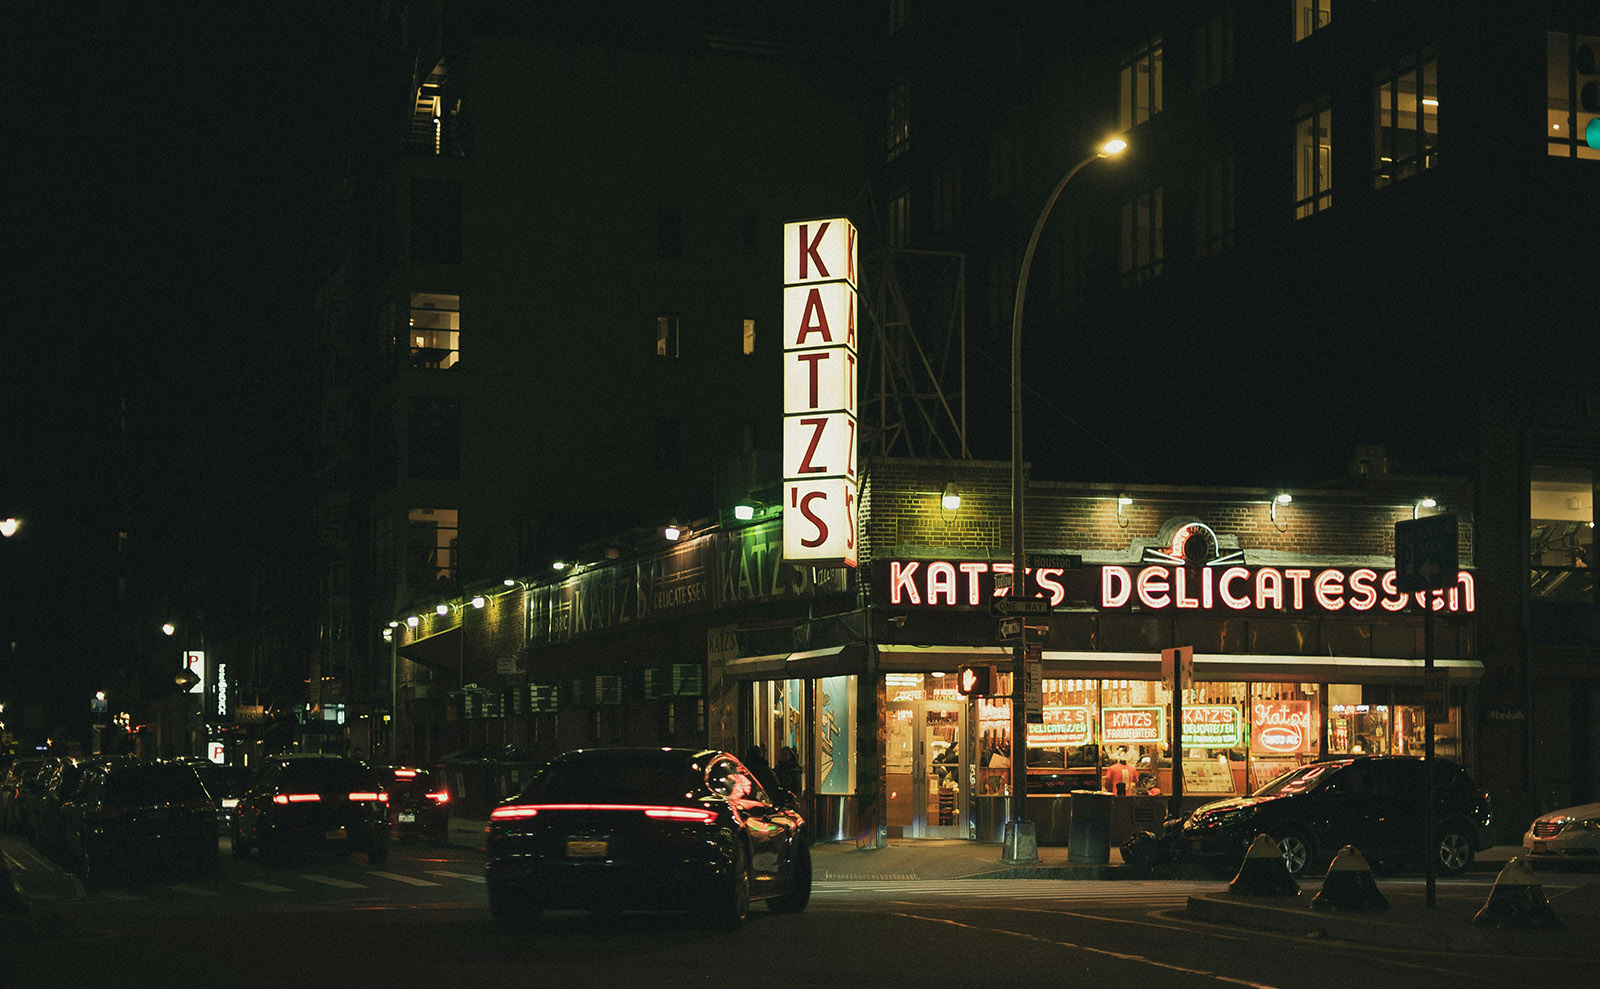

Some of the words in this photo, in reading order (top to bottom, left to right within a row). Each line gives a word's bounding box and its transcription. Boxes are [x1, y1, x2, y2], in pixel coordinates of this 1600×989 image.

[791, 221, 833, 549] KATZ'S
[1034, 556, 1072, 568] Houston
[720, 541, 808, 602] KATZS
[654, 582, 707, 609] DELICATESSEN
[1000, 602, 1016, 610] ONE
[1025, 602, 1044, 610] WAY
[1043, 711, 1086, 721] ATZS
[1113, 712, 1152, 727] KATZ'S
[1184, 709, 1233, 723] KATZ'S
[1029, 723, 1087, 733] DELICATESSEN
